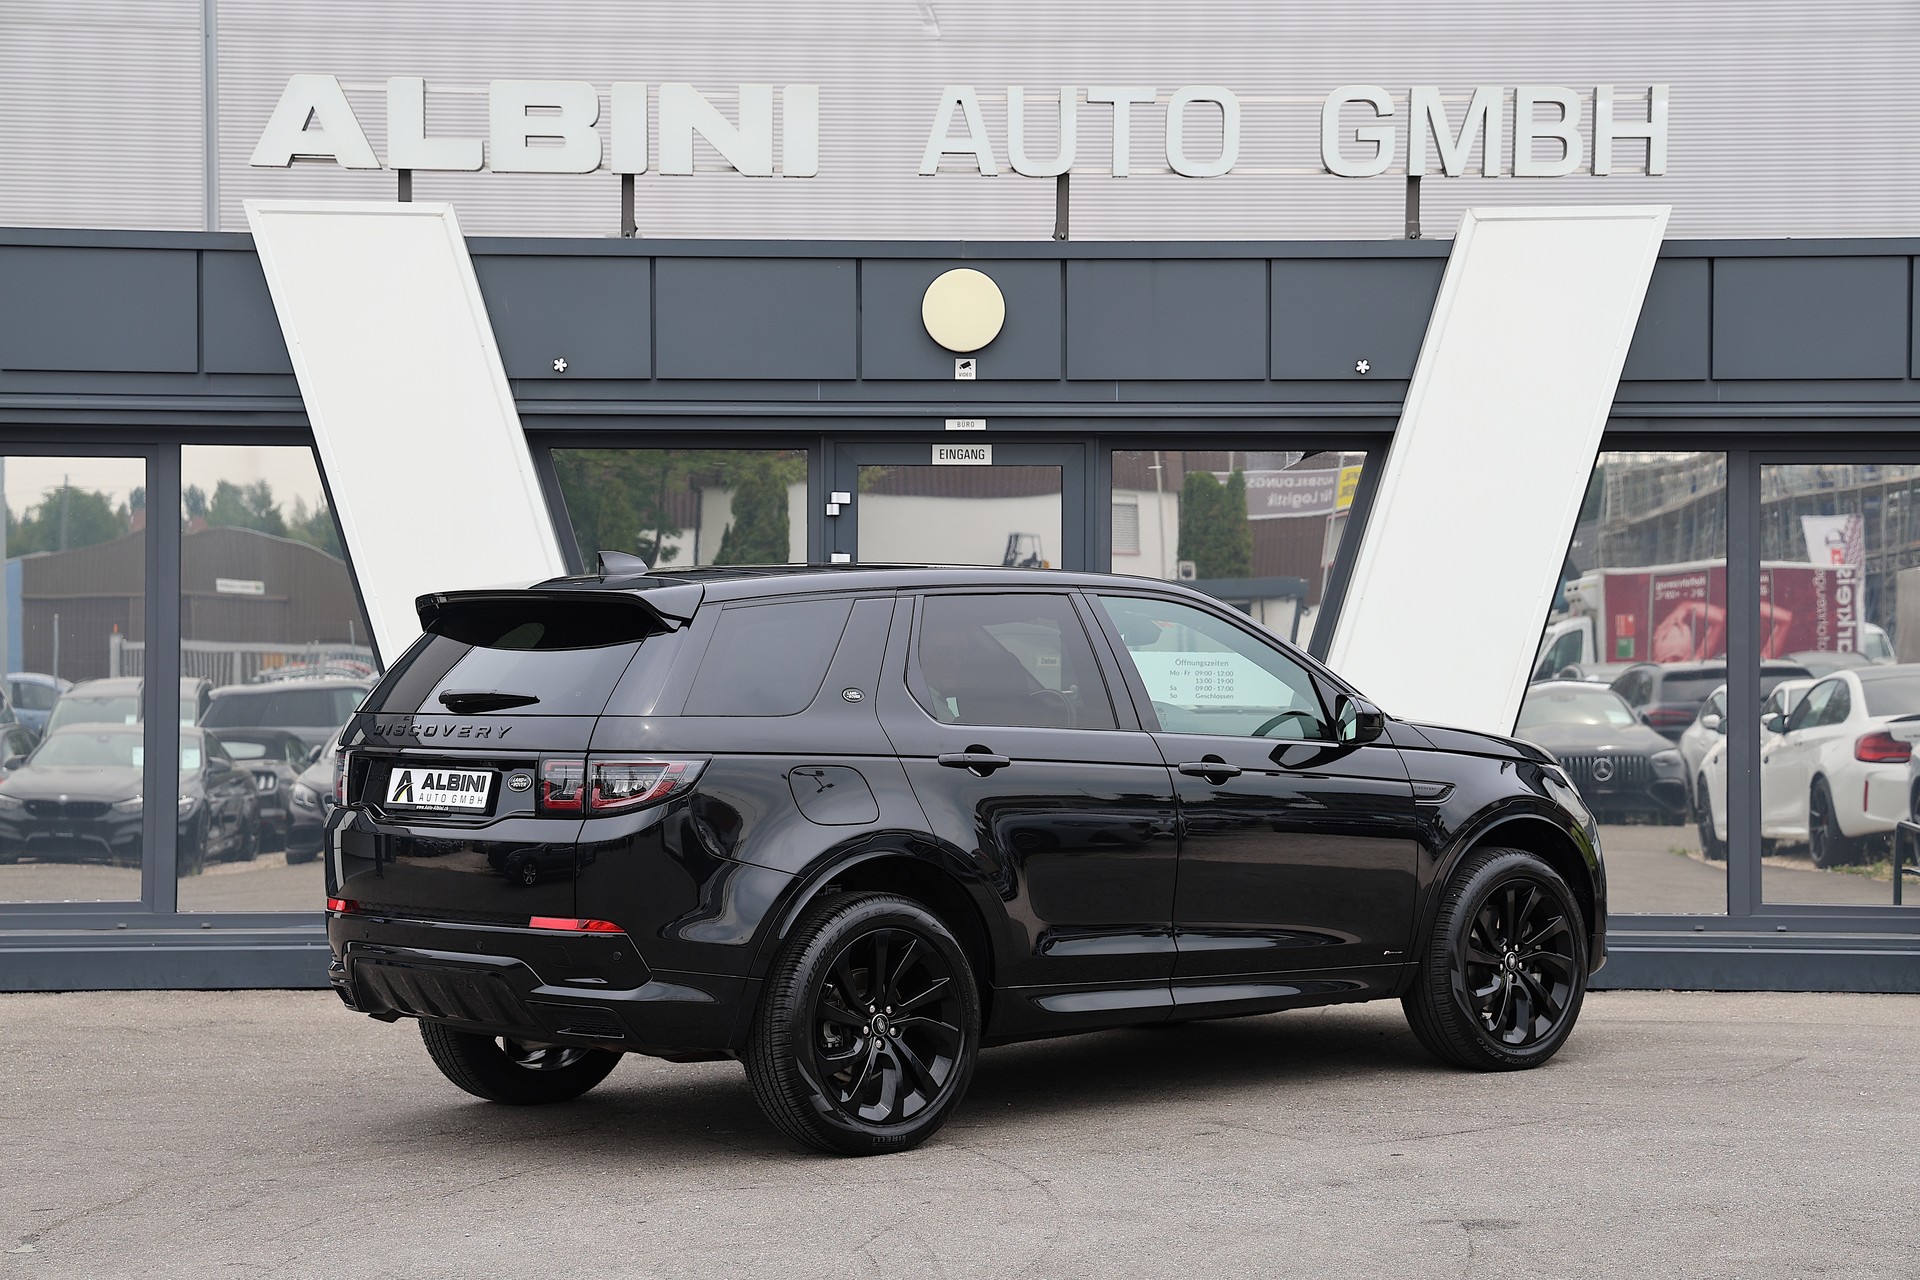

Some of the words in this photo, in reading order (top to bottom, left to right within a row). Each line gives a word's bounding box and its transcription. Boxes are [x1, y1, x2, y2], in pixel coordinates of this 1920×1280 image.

[248, 73, 820, 178] ALBINI
[918, 84, 1241, 178] AUTO
[1320, 84, 1669, 178] GMBH
[956, 420, 975, 428] BÜRO
[939, 448, 985, 460] EINGANG
[1174, 658, 1229, 667] Öffnungszeiten
[373, 723, 513, 739] DISCOVERY
[421, 772, 487, 793] ALBINI
[419, 792, 447, 803] AUTO
[451, 794, 484, 805] GMBH
